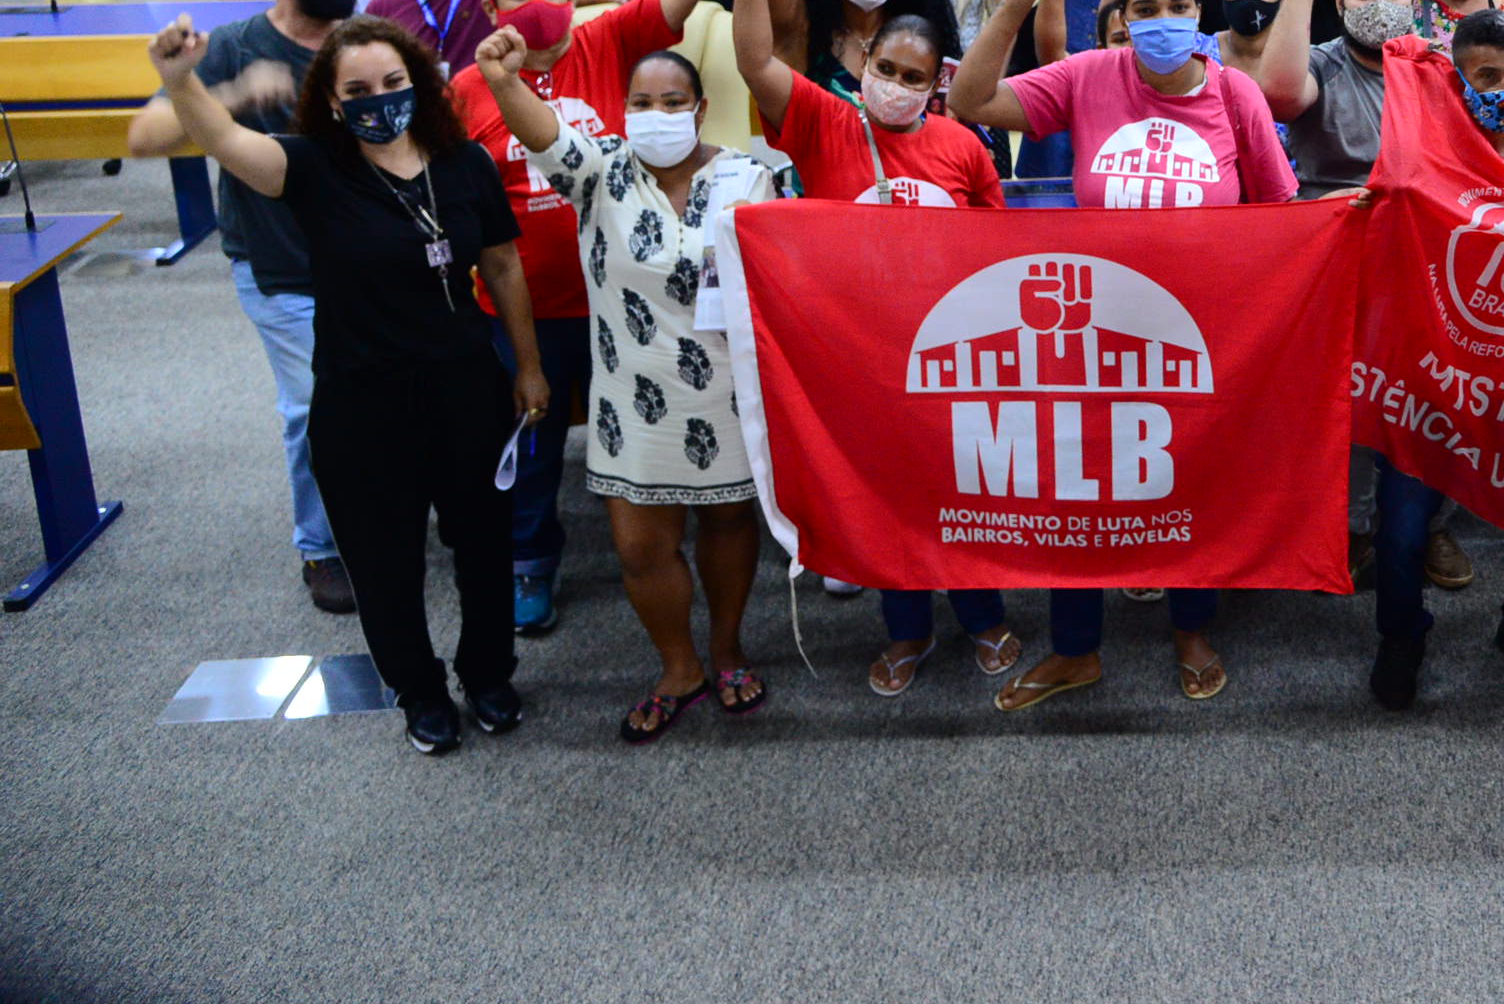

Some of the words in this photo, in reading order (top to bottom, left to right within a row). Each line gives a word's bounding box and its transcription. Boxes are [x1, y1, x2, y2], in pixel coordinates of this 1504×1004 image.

[1445, 319, 1468, 348] PELA
[951, 400, 1174, 502] MLB
[938, 507, 1061, 530] MOVIMENTO
[1067, 516, 1091, 531] DE
[1098, 516, 1145, 531] LUTA
[1151, 508, 1193, 526] NOS
[941, 527, 1029, 546] BAIRROS,
[1034, 533, 1088, 547] VILAS
[1094, 534, 1103, 547] E
[1110, 526, 1192, 546] FAVELAS
